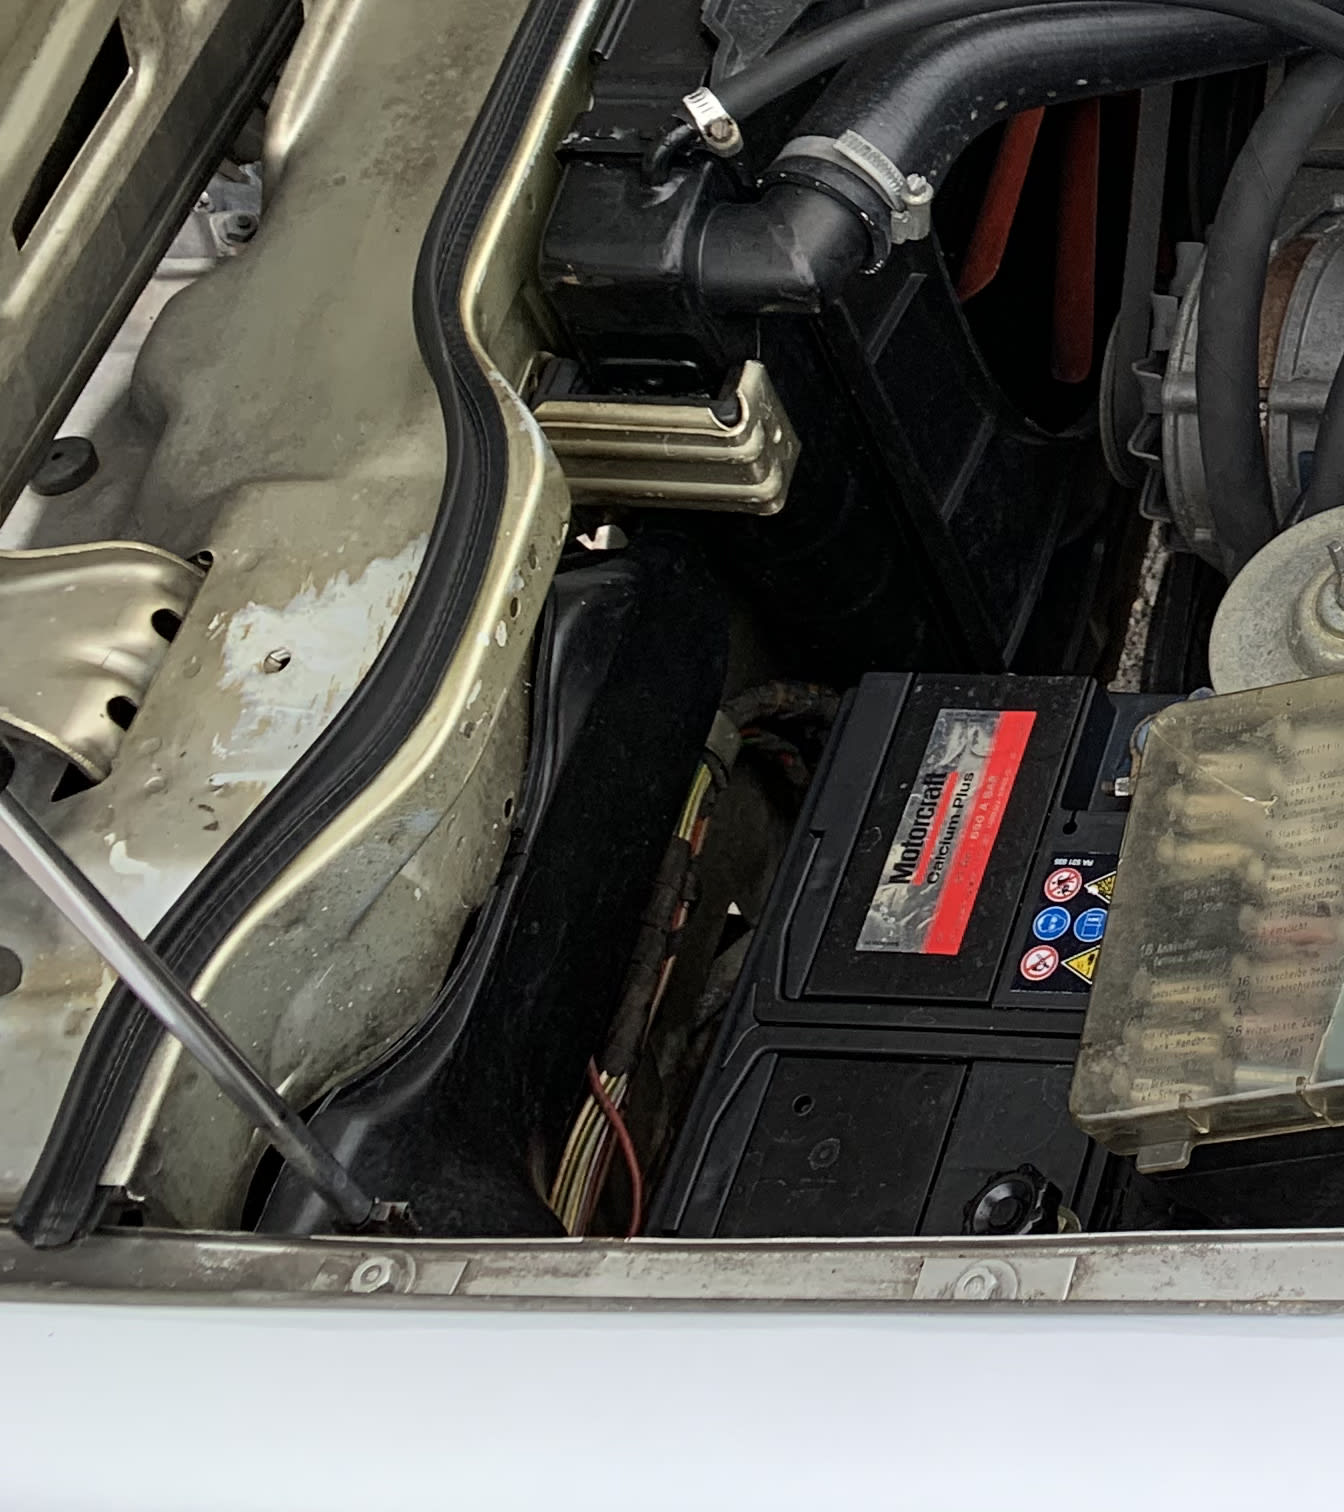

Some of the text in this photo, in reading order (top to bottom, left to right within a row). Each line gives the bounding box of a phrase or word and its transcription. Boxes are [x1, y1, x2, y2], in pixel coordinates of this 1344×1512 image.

[889, 772, 947, 885] Motorcraft
[926, 813, 961, 886] Calcium
[952, 772, 974, 809] Plus
